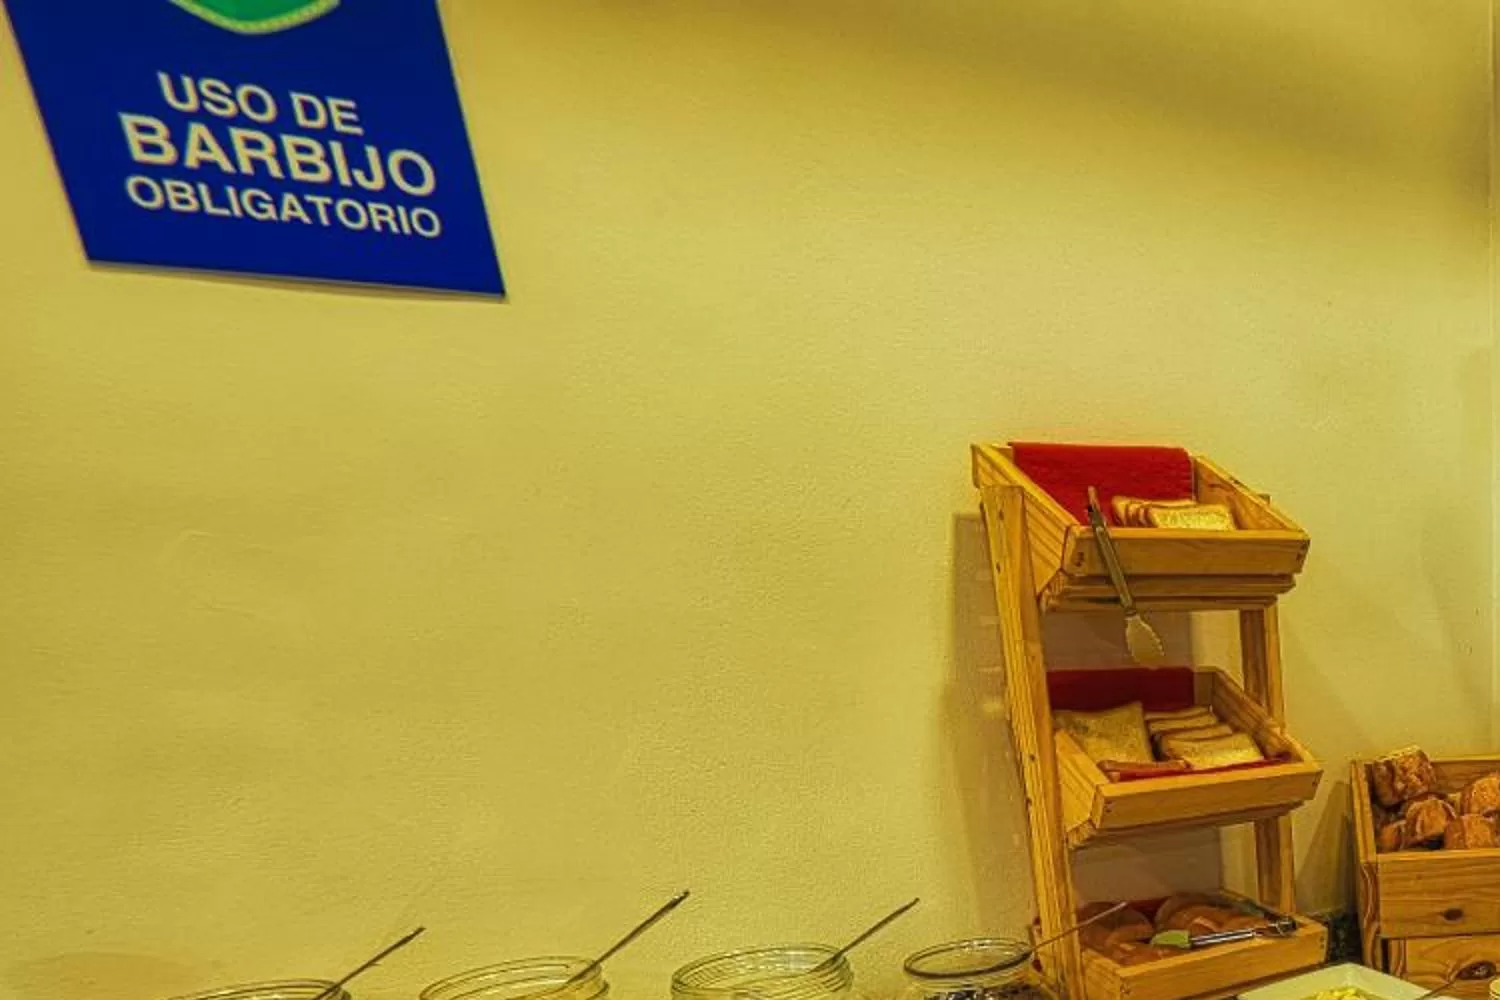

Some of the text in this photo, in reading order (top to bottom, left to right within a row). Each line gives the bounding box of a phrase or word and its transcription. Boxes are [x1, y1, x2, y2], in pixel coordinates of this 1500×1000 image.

[157, 70, 364, 136] USO DE
[118, 111, 437, 197] BARBIJO
[125, 175, 442, 239] OBLIGATORIO
